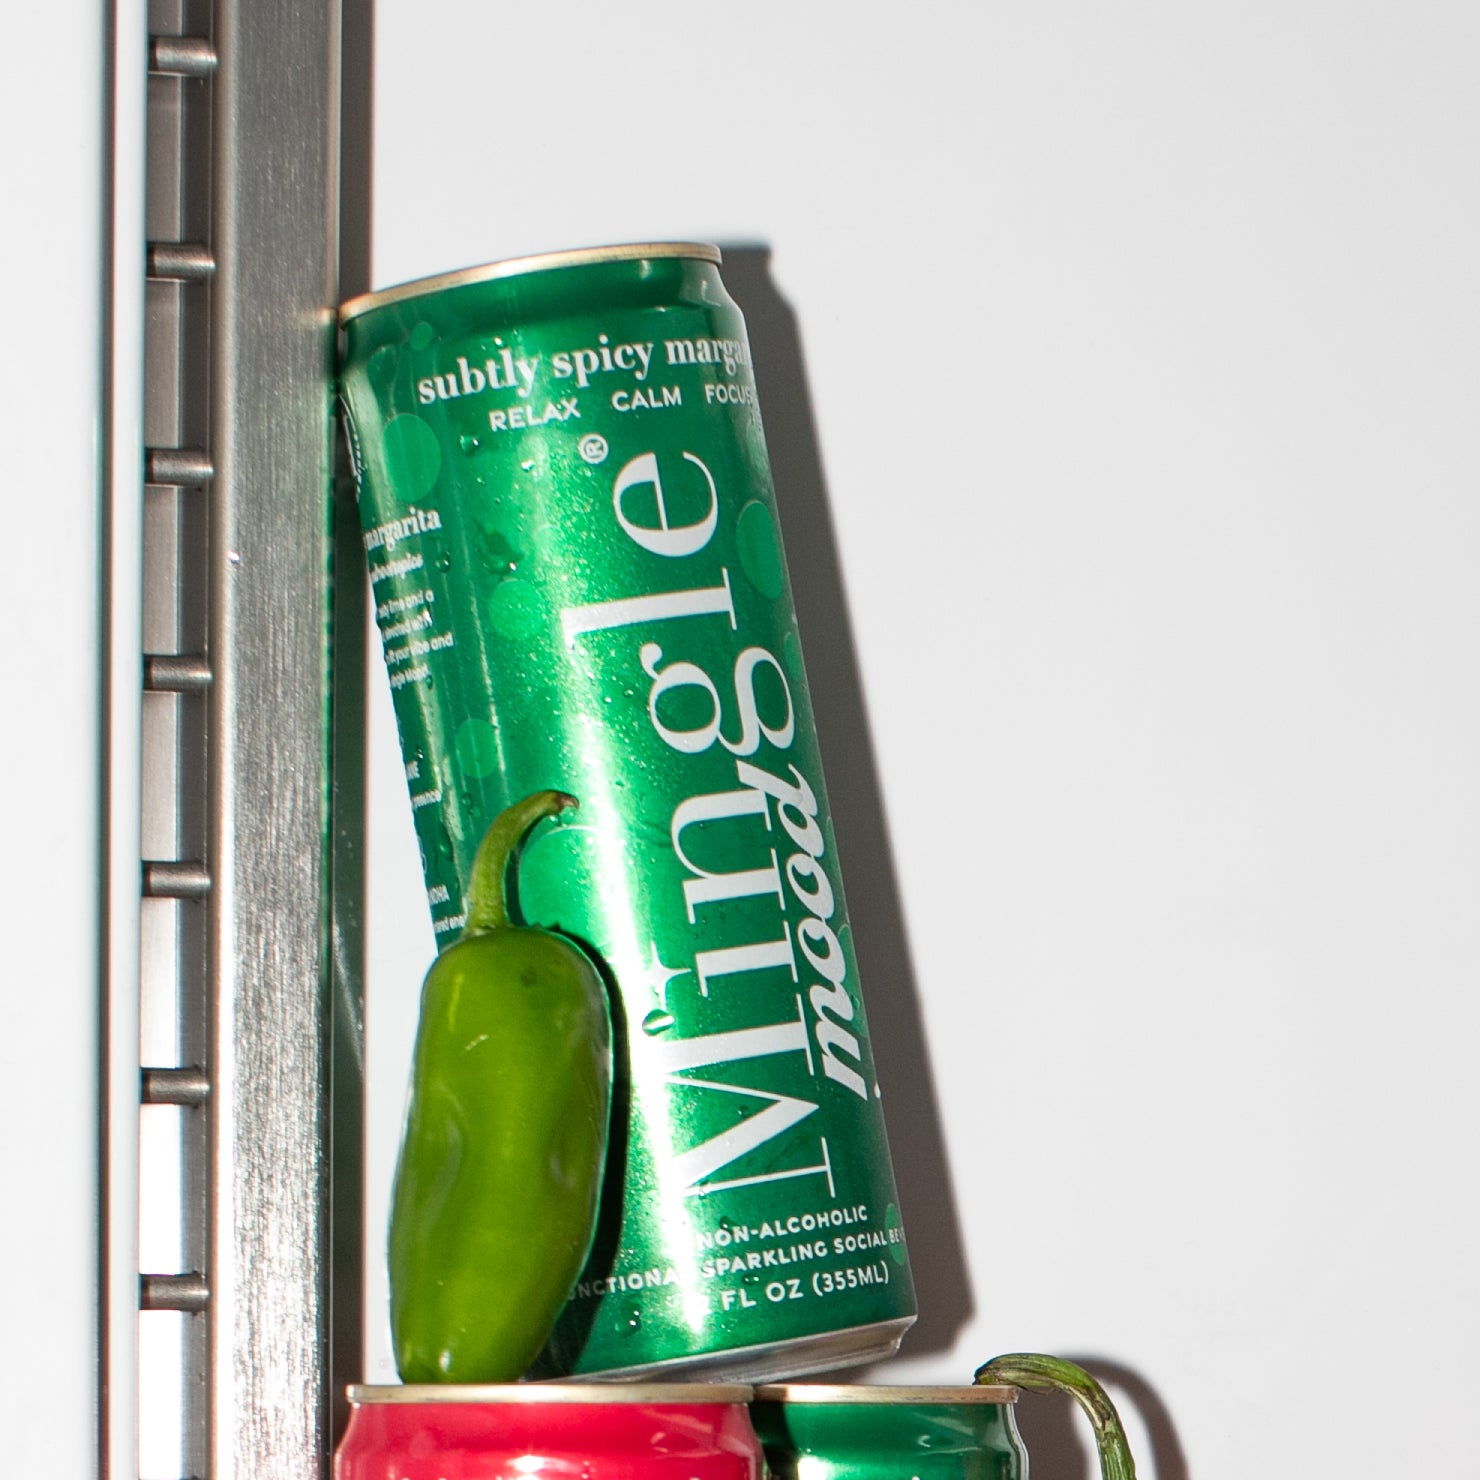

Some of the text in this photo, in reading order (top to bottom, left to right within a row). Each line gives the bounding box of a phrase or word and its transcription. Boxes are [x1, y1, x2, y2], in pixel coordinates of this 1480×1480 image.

[418, 334, 655, 405] subtly spicy
[487, 383, 753, 432] RELAX CALM FOCUS
[737, 760, 870, 1100] mood
[697, 1204, 869, 1249] NON-ALCOHOLIC
[702, 1234, 888, 1280] SPARKLING SOCIAL
[721, 1261, 889, 1311] FL OZ (355ML)
